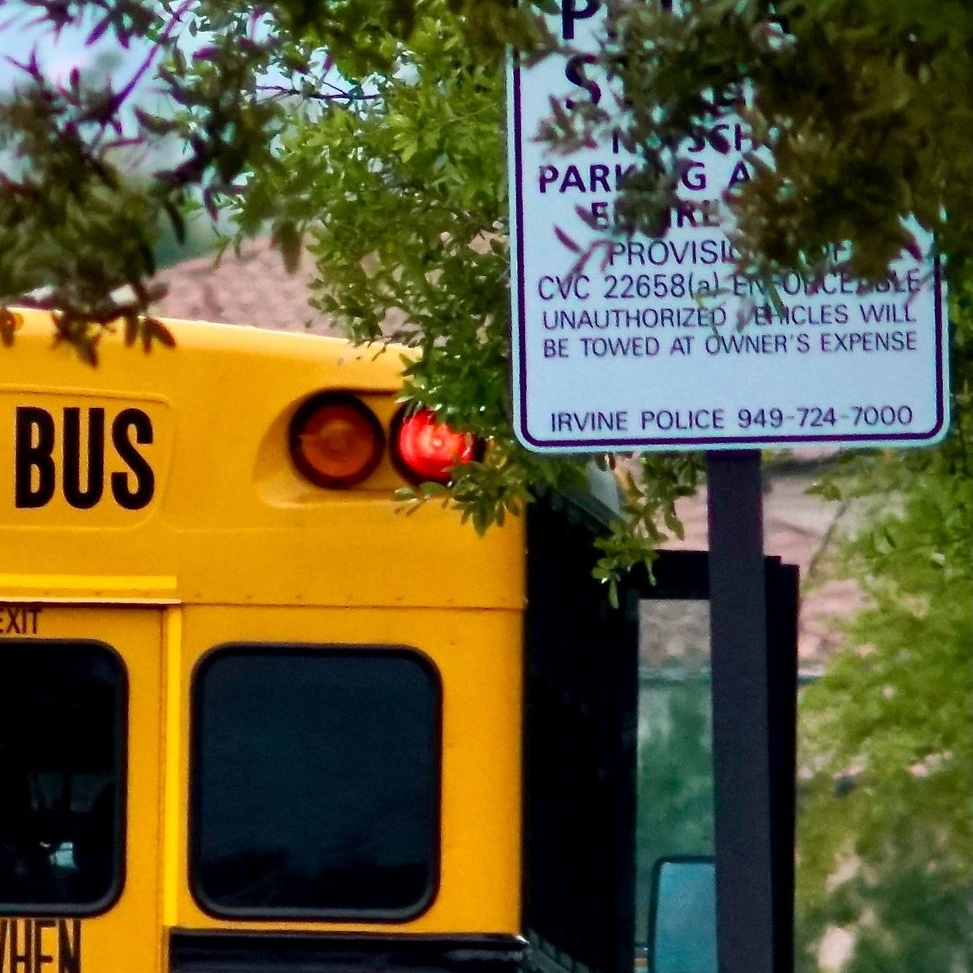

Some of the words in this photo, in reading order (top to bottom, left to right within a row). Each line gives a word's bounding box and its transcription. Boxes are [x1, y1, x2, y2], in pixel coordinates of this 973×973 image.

[538, 275, 590, 300] CVC
[542, 307, 727, 330] UNAUTHORIZED
[859, 303, 917, 324] WILL
[543, 338, 569, 359] BE
[580, 336, 660, 357] TOWED
[670, 335, 695, 356] AT
[705, 332, 811, 355] OWNER'S
[821, 330, 917, 352] EXPENSE
[551, 411, 628, 432] IRVINE
[641, 409, 724, 430] POLICE
[737, 405, 913, 429] 949-724-7000
[15, 405, 155, 511] BUS
